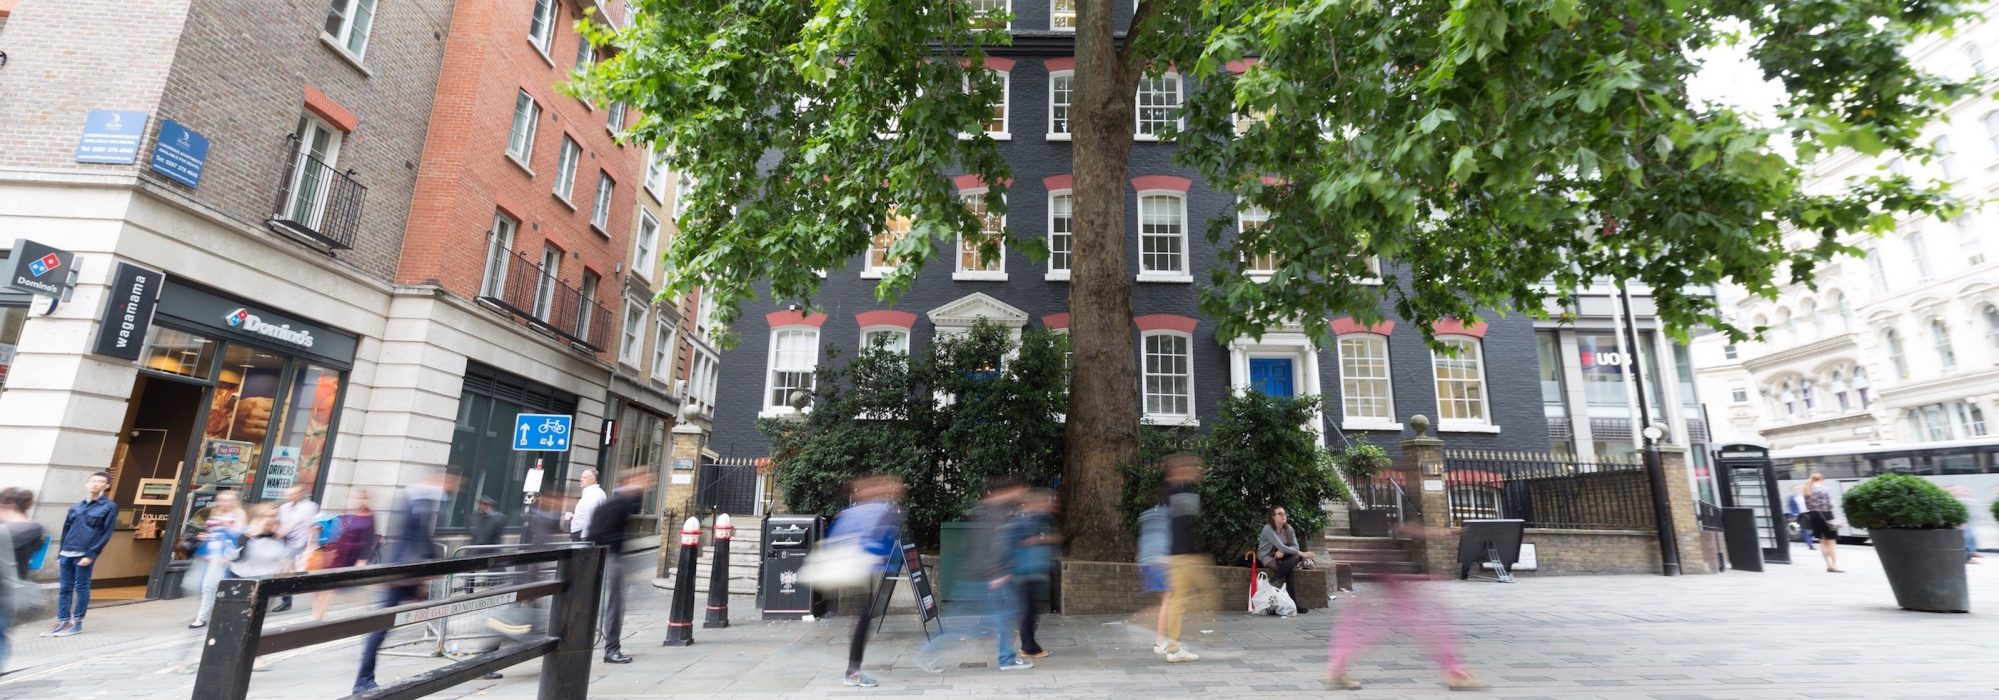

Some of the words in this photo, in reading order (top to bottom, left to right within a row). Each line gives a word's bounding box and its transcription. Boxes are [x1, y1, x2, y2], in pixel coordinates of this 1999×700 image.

[17, 276, 58, 293] Domino's
[116, 275, 146, 348] wagamama
[243, 314, 314, 348] Domino's
[269, 464, 294, 476] DRIVERS
[266, 477, 292, 489] WANTED
[141, 513, 171, 521] COLLEC
[414, 610, 430, 621] FIRE
[431, 607, 449, 618] GATE
[450, 604, 461, 614] DO
[461, 601, 475, 612] NOT
[475, 596, 505, 609] OBSTRUCT
